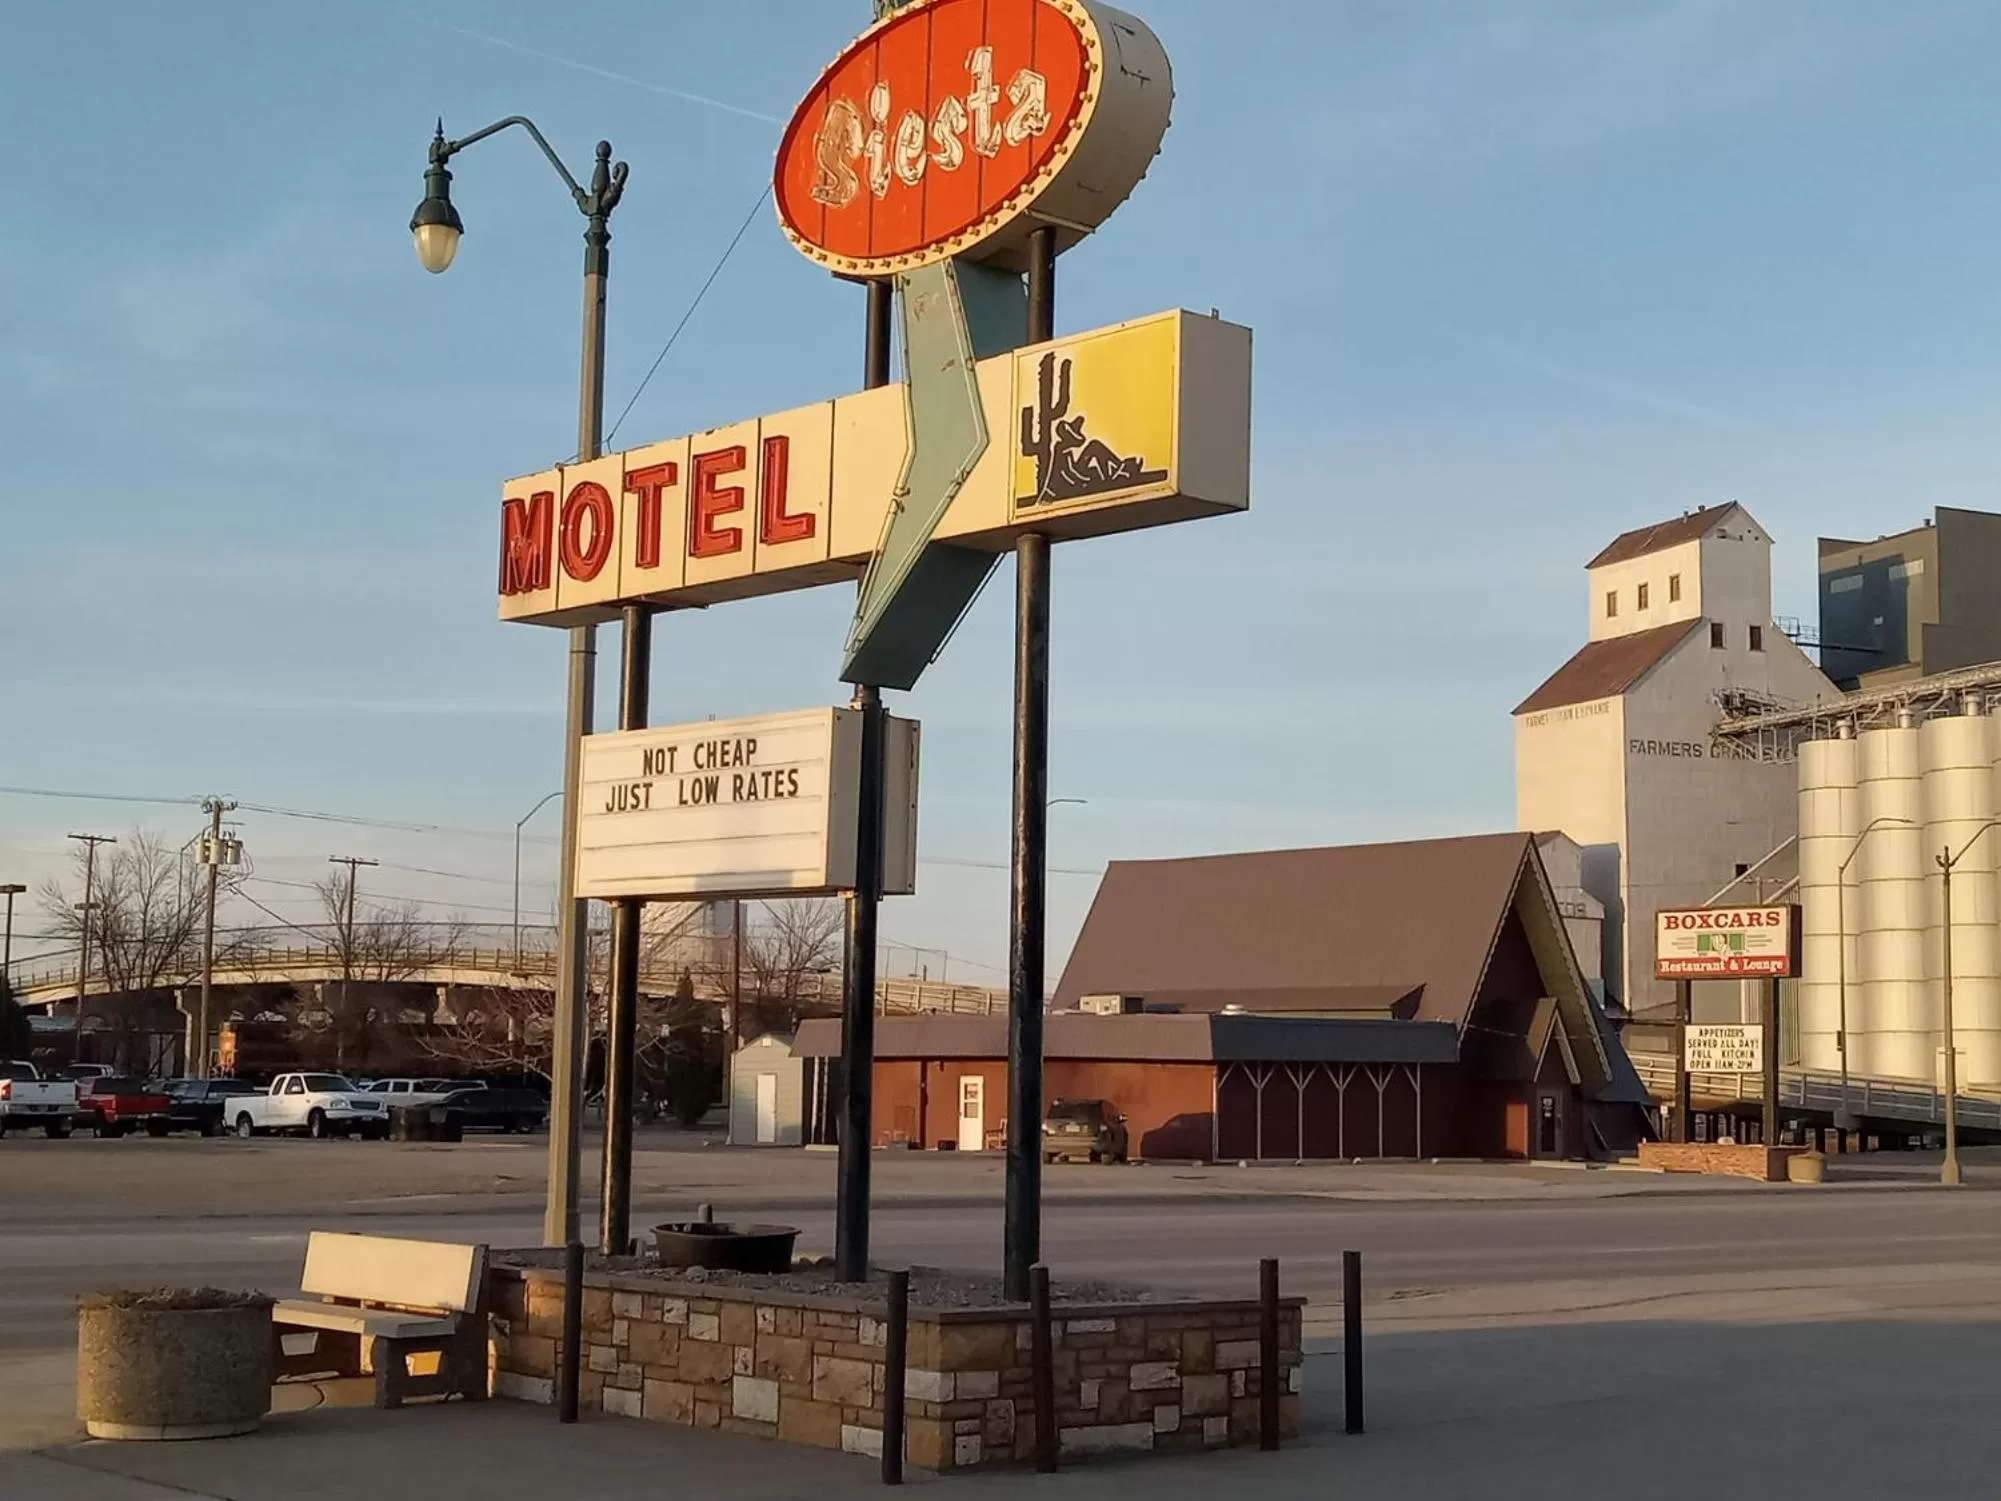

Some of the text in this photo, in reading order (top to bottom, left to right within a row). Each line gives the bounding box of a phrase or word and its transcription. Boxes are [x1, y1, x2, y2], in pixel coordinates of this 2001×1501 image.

[810, 45, 1052, 207] Siesta
[499, 435, 816, 596] MOTEL
[643, 738, 757, 776] NOT CHEAP
[1629, 739, 1703, 758] FARMERS
[606, 768, 799, 812] JUST LOW RATES
[1664, 911, 1780, 930] BOXCARS
[1661, 959, 1783, 972] Restaurant & Lounge
[1699, 1028, 1745, 1037] APPETIZERS
[1688, 1039, 1718, 1048] SERVED
[1720, 1039, 1736, 1048] ALL
[1692, 1049, 1712, 1059] FULL
[1690, 1060, 1711, 1069] OPEN
